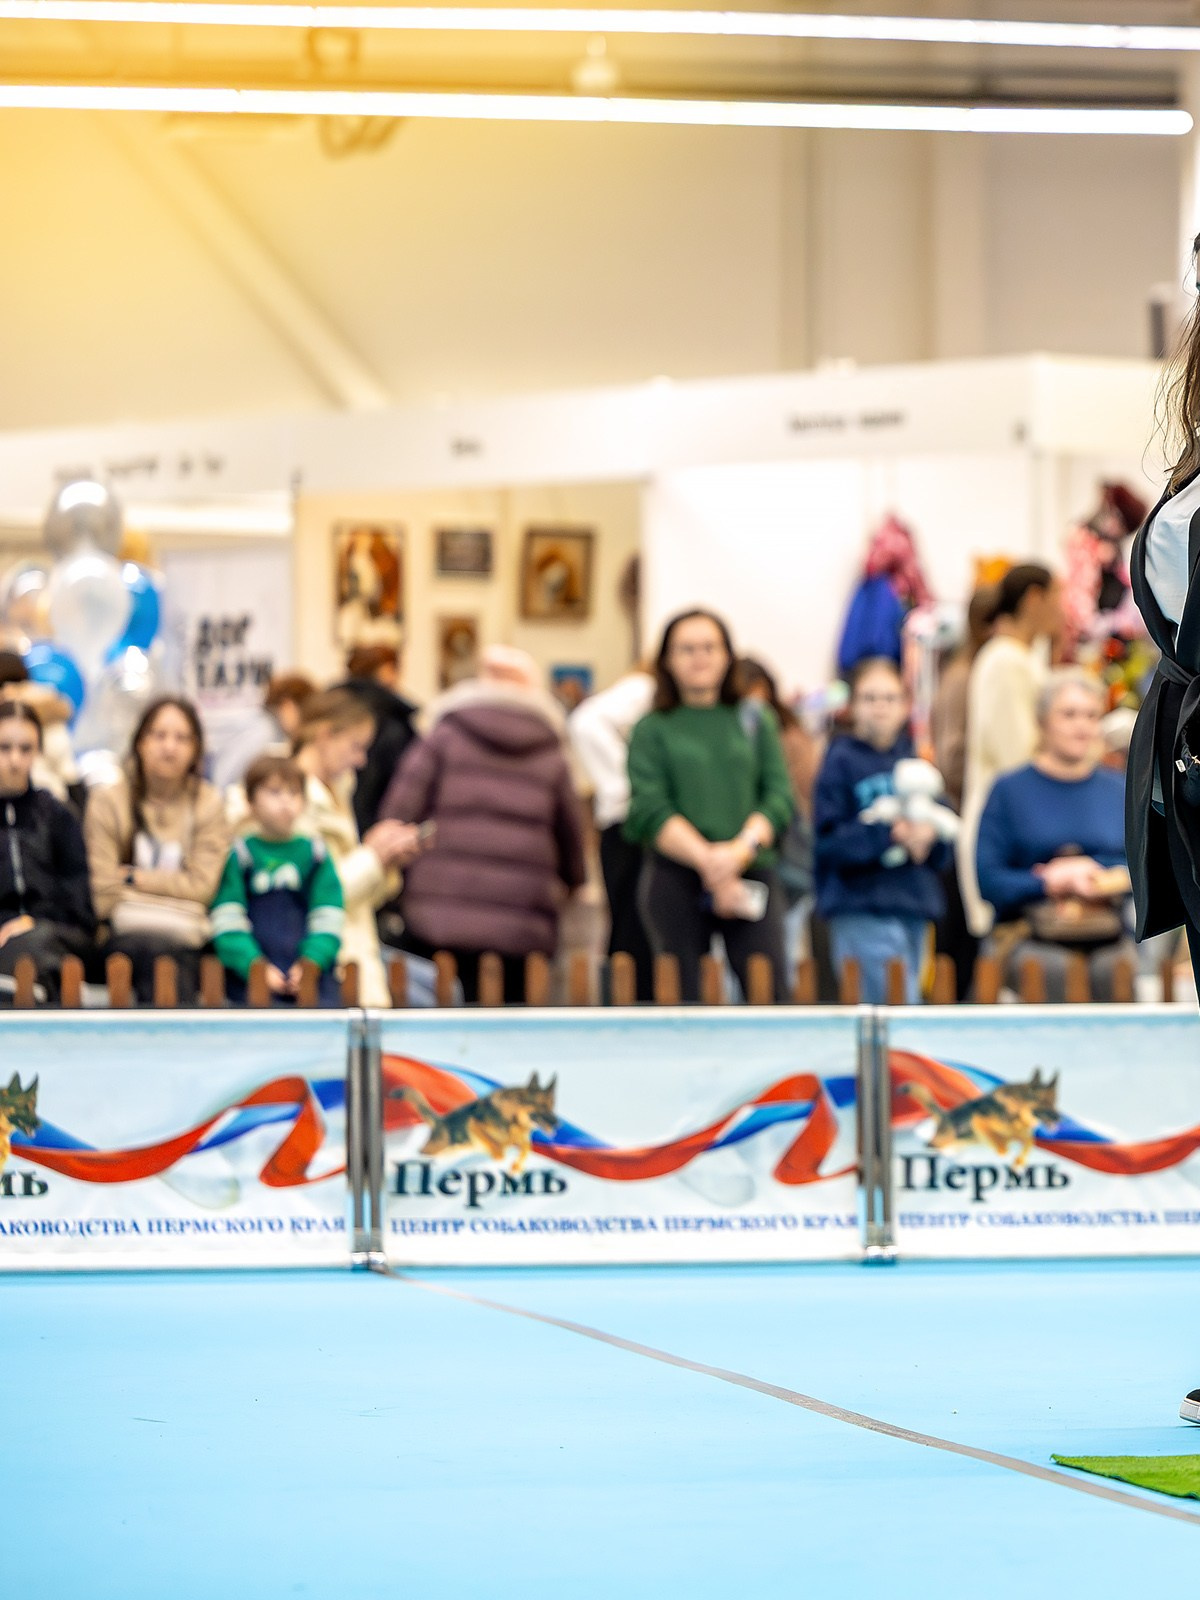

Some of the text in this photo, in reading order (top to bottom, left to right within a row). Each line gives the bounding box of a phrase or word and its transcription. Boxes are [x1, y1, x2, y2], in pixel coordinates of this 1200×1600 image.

[392, 1160, 567, 1209] Пермь
[902, 1155, 1070, 1202] Пермь
[147, 1216, 284, 1236] ПЕРМСКОГО
[291, 1216, 346, 1234] КРАЯ
[390, 1214, 859, 1235] ЦЕНТР СОБАКОВОДСТВА ПЕРМСКОГО КРАЯ
